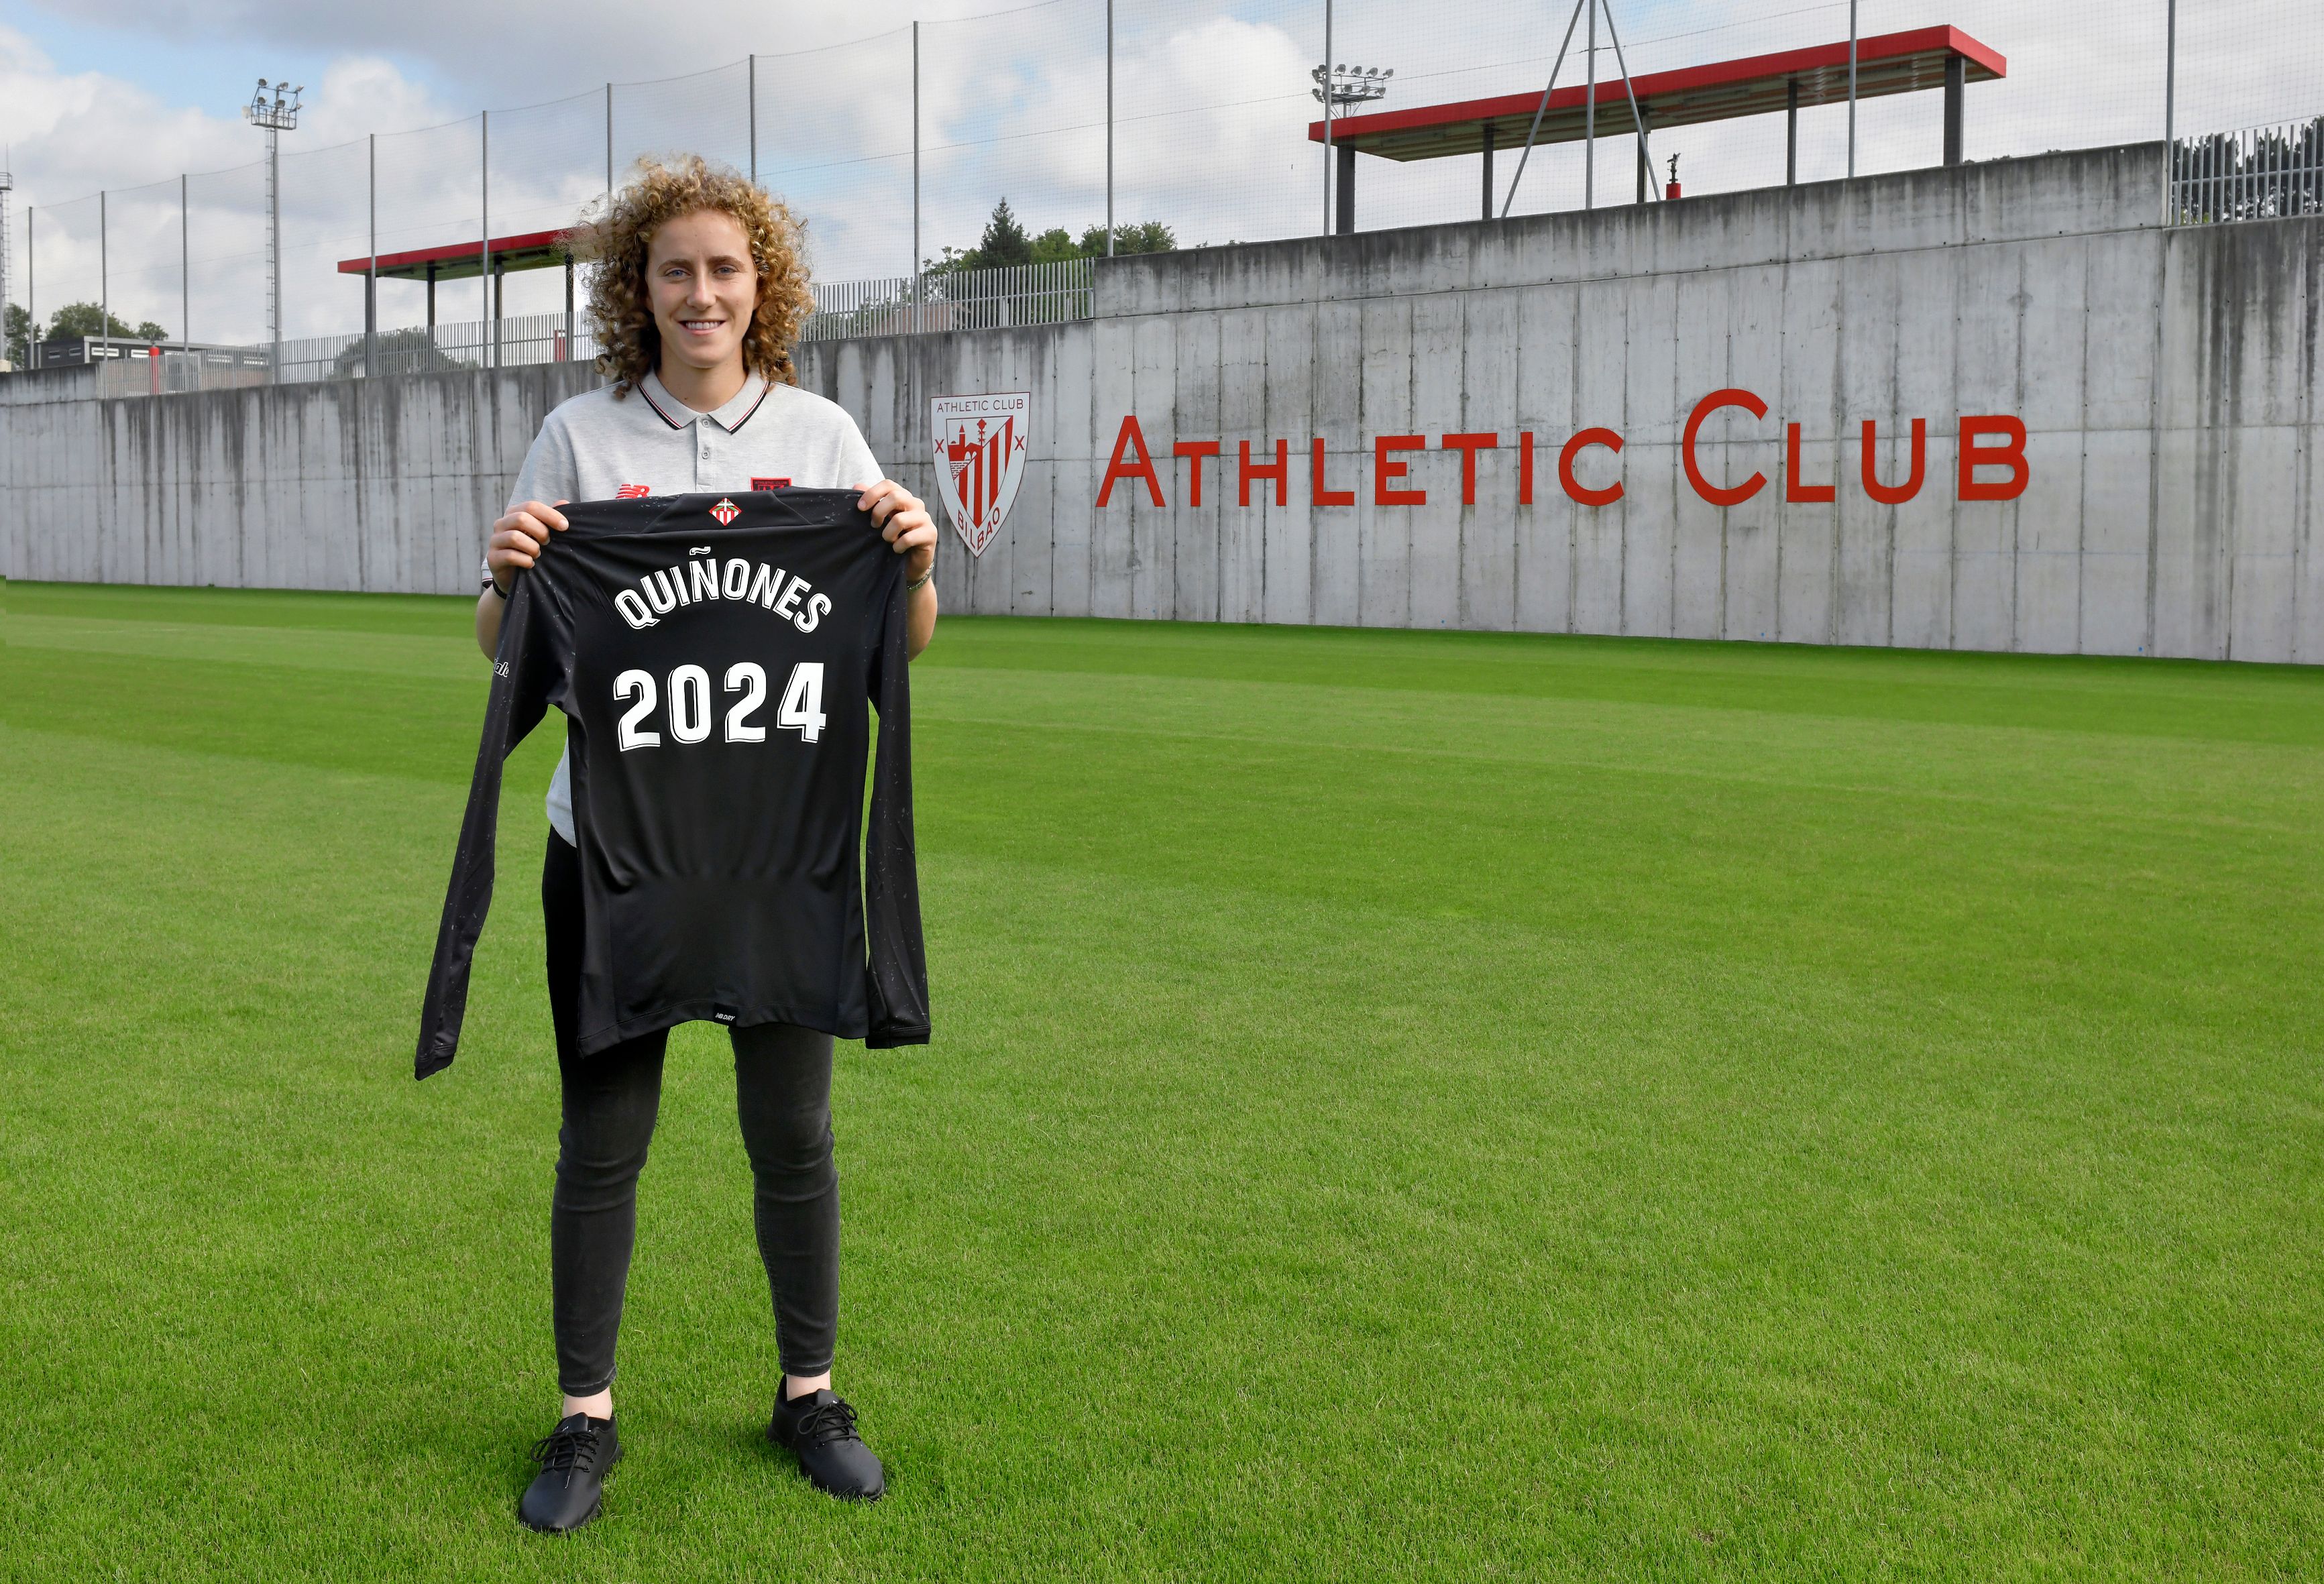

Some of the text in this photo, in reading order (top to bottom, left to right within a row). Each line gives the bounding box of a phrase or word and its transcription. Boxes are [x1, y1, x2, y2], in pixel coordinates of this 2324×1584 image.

[937, 398, 1024, 413] ATHLETIC CLUB
[1096, 388, 2030, 508] ATHLETIC CLUB
[958, 506, 1001, 551] BILBAO
[614, 546, 832, 633] QUIÑONES
[613, 661, 827, 752] 2024
